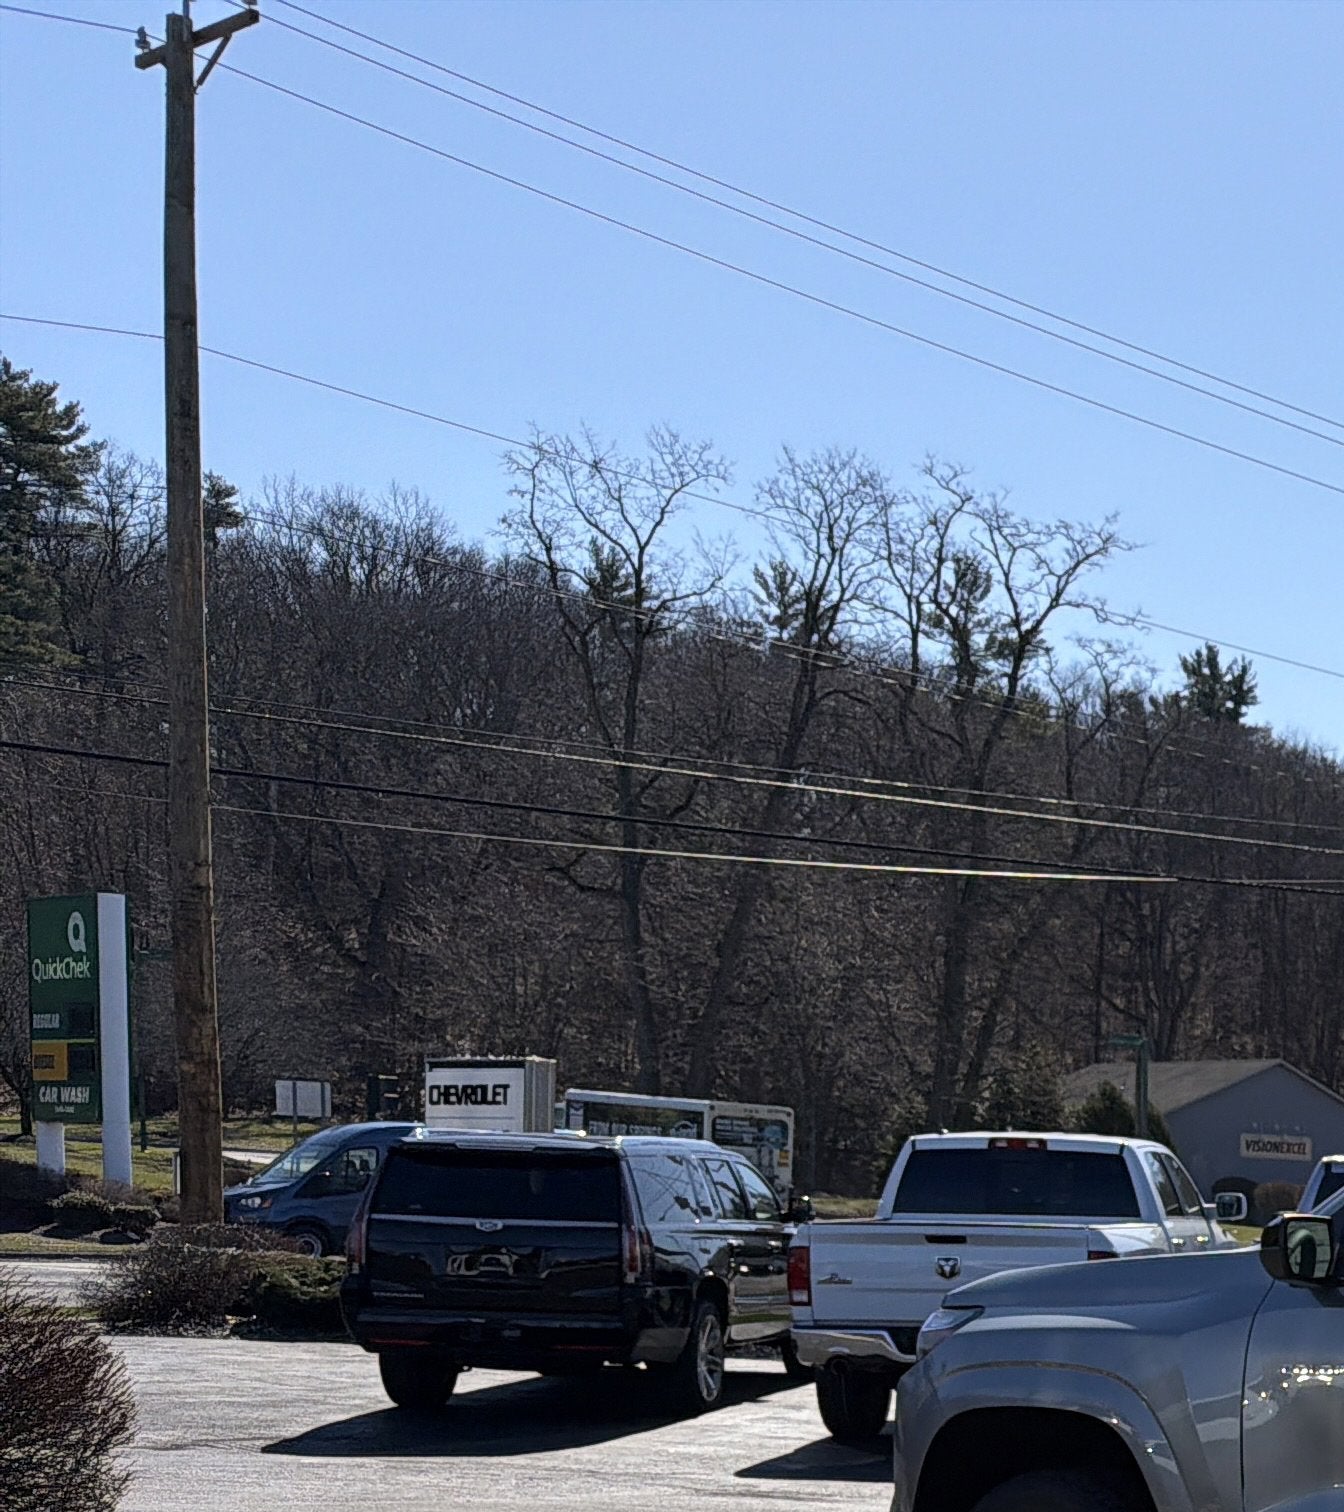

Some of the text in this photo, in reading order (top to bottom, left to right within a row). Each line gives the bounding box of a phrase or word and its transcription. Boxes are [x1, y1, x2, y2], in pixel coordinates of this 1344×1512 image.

[32, 955, 91, 984] QuickChek
[39, 1086, 90, 1103] CAR WASH
[429, 1084, 510, 1106] CHEVROLET
